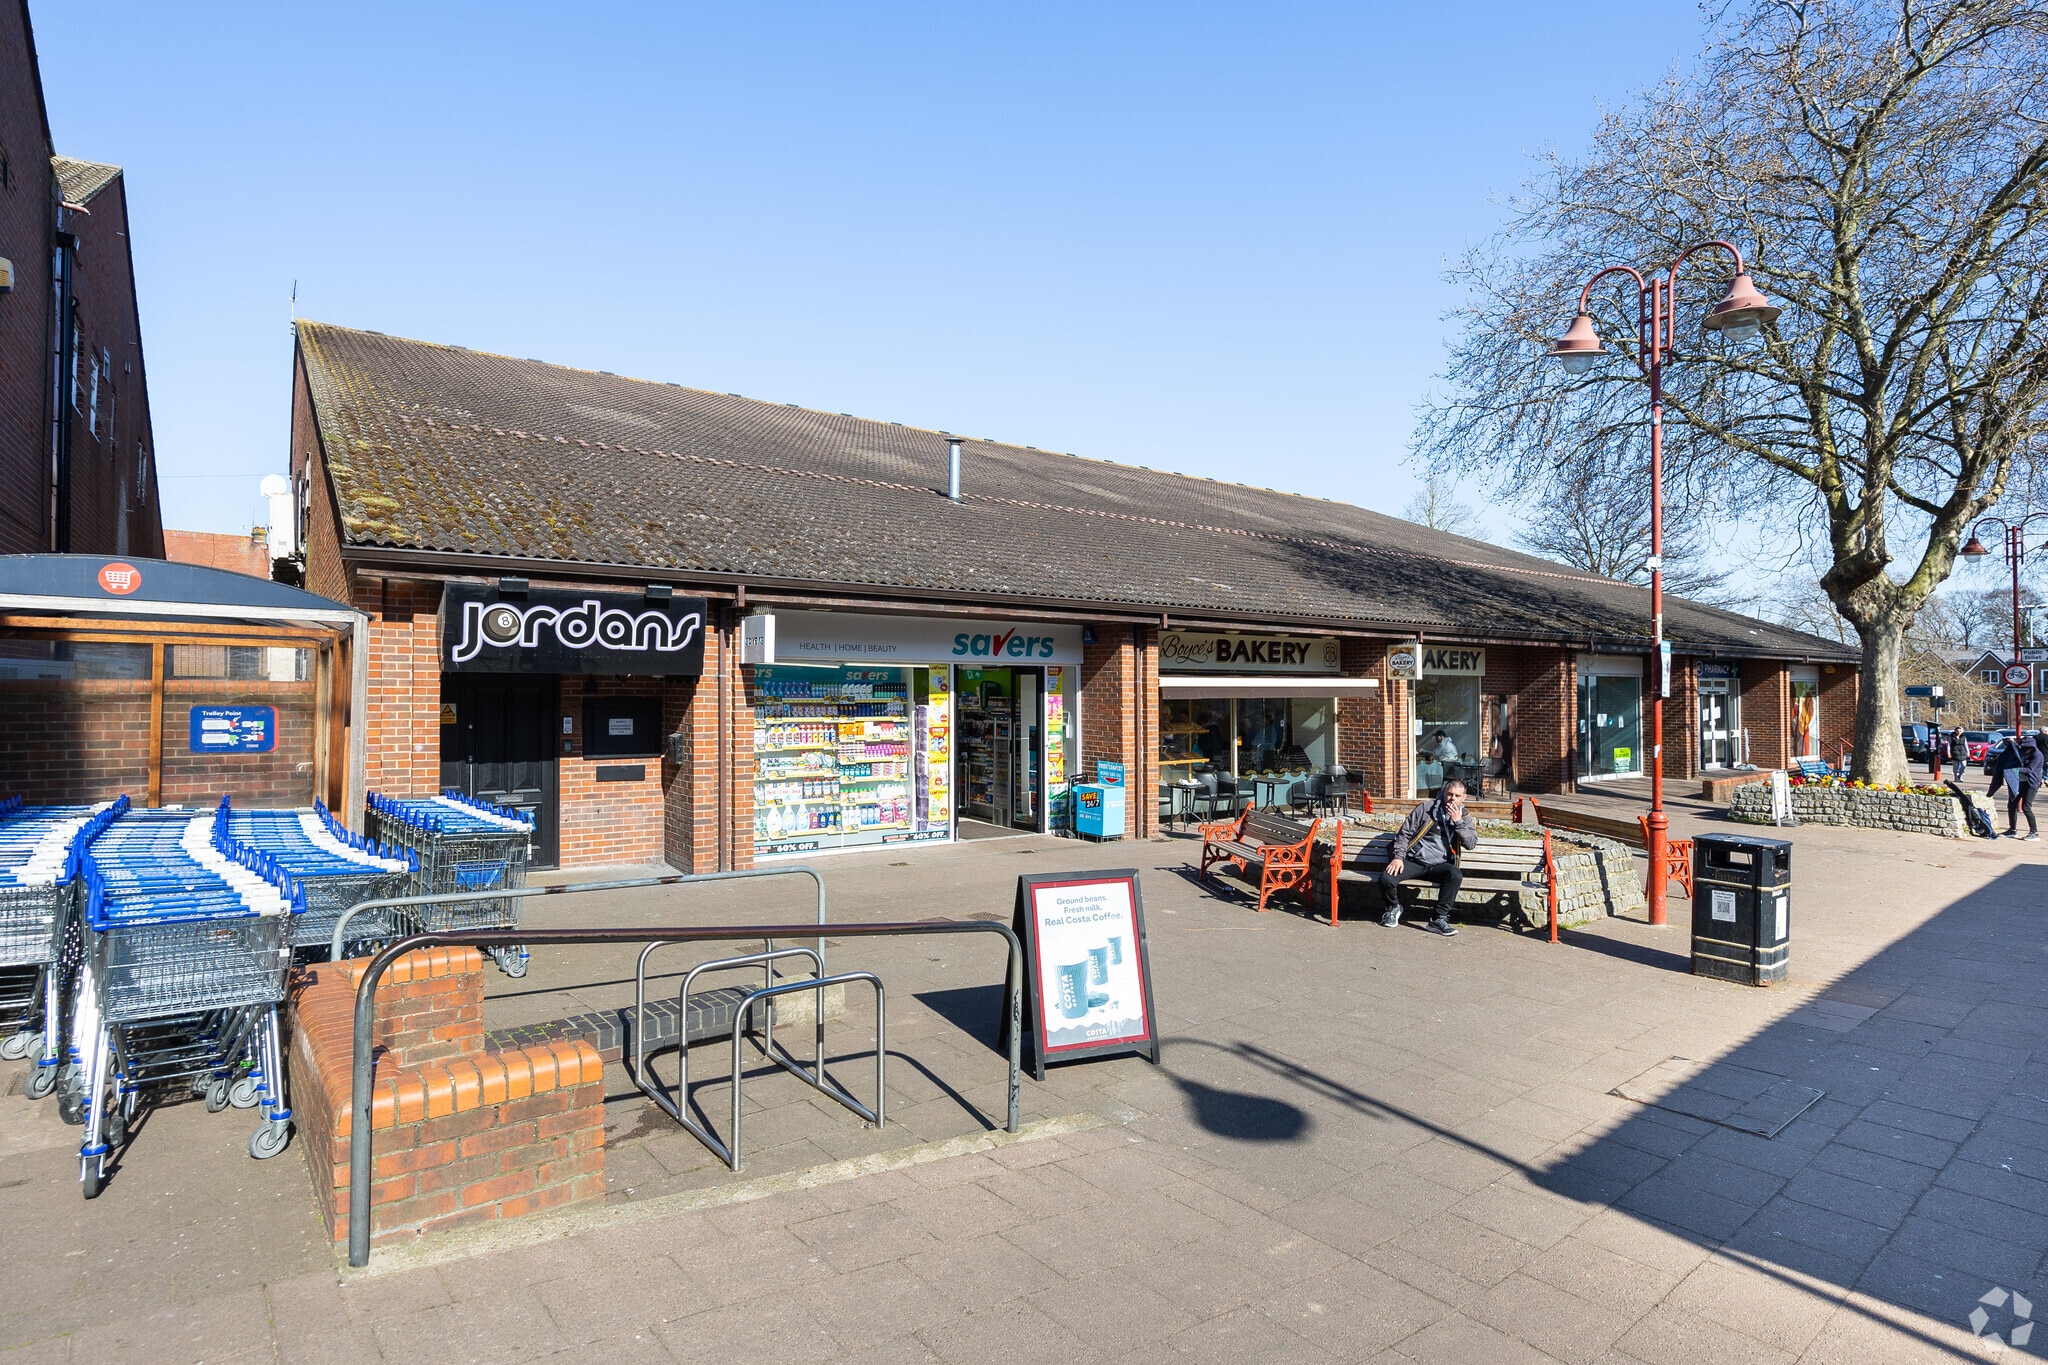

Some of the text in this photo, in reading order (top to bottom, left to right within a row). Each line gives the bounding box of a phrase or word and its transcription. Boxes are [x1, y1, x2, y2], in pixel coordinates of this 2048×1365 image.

[952, 627, 1054, 658] savers
[799, 643, 897, 653] HEALTH HOME BEAUTY
[1159, 635, 1312, 665] Boyce's BAKERY
[1422, 649, 1481, 671] AKERY
[1705, 664, 1729, 674] PHARMACY
[846, 669, 889, 681] savers
[1081, 792, 1097, 801] SAVE
[913, 832, 930, 840] 60%
[777, 844, 796, 852] 60%
[1056, 896, 1083, 905] Ground
[1063, 904, 1103, 914] Fresh milk.
[1045, 911, 1123, 926] Real Costa Coffee.
[1061, 975, 1073, 1010] COSTA
[1086, 1028, 1107, 1037] COSTA
